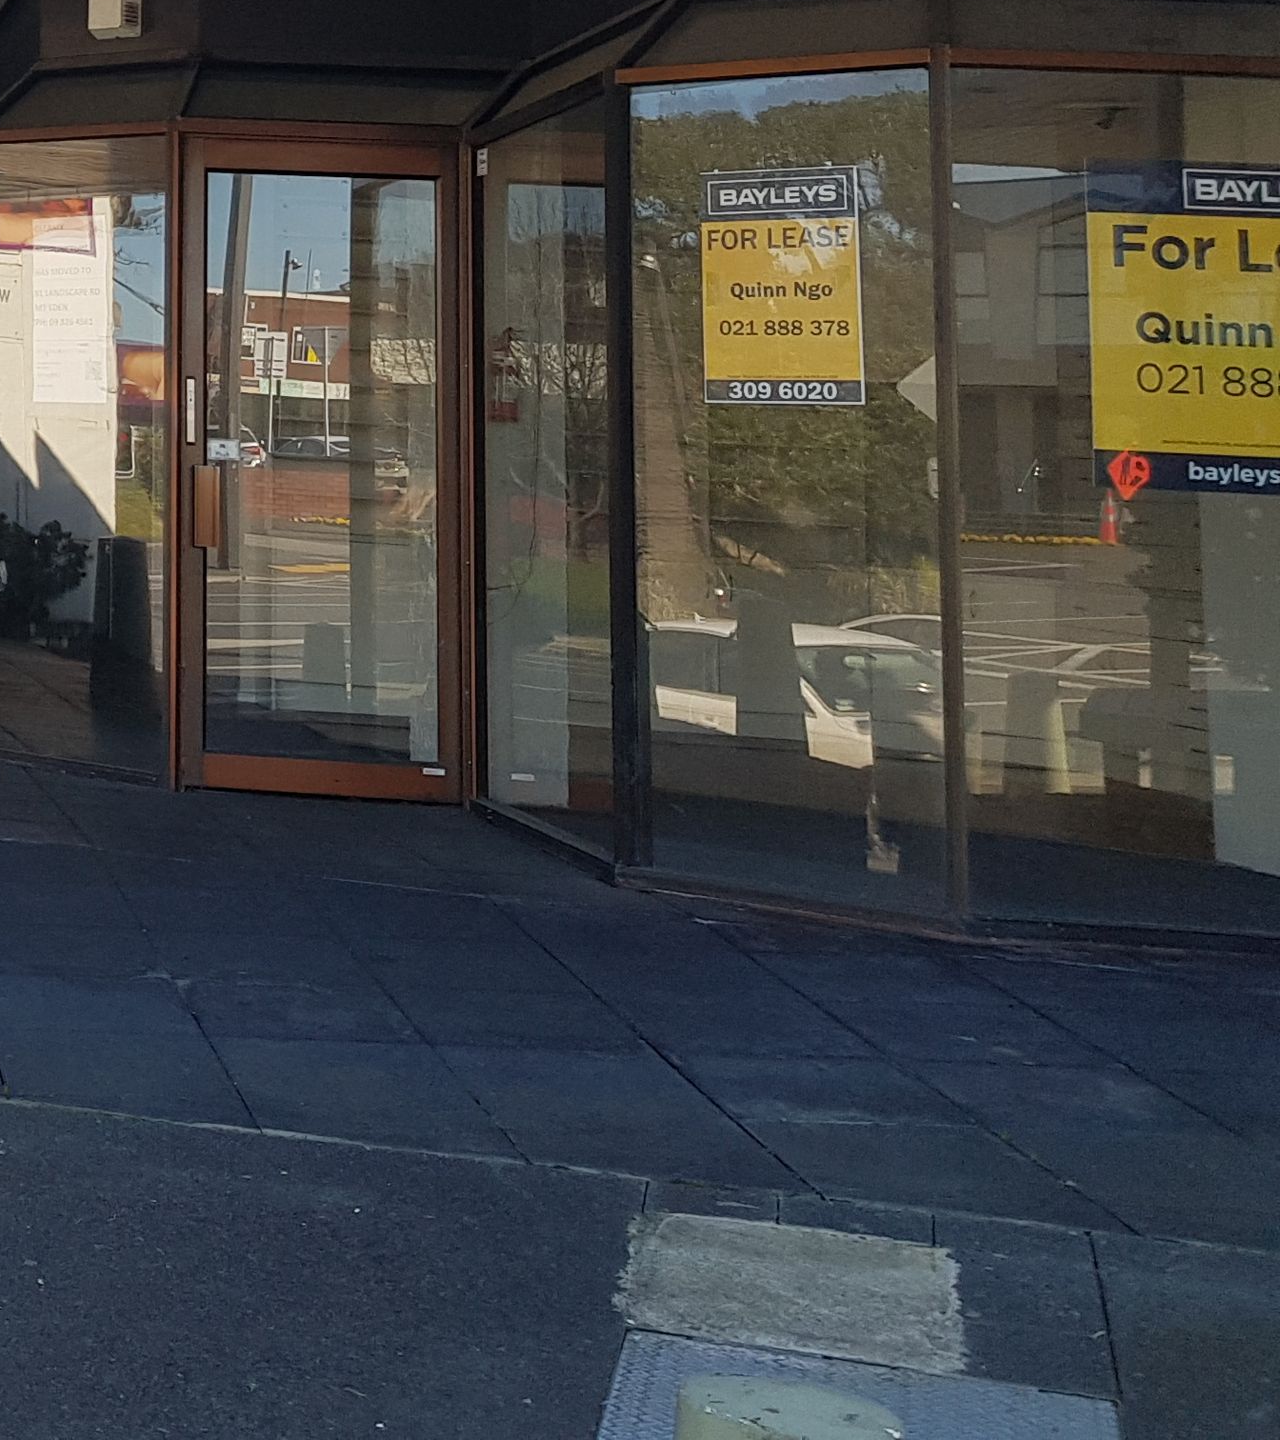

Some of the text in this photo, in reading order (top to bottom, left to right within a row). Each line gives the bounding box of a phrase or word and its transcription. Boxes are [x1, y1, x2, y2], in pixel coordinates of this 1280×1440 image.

[719, 185, 837, 207] BAYLEYS
[707, 225, 850, 251] FOR LEASE
[1112, 224, 1215, 270] For
[730, 281, 833, 301] Quinn Ngo
[720, 320, 850, 336] 021 888 378
[1136, 311, 1273, 348] Quinn
[728, 382, 838, 400] 309 6020
[1136, 363, 1280, 398] 021 88
